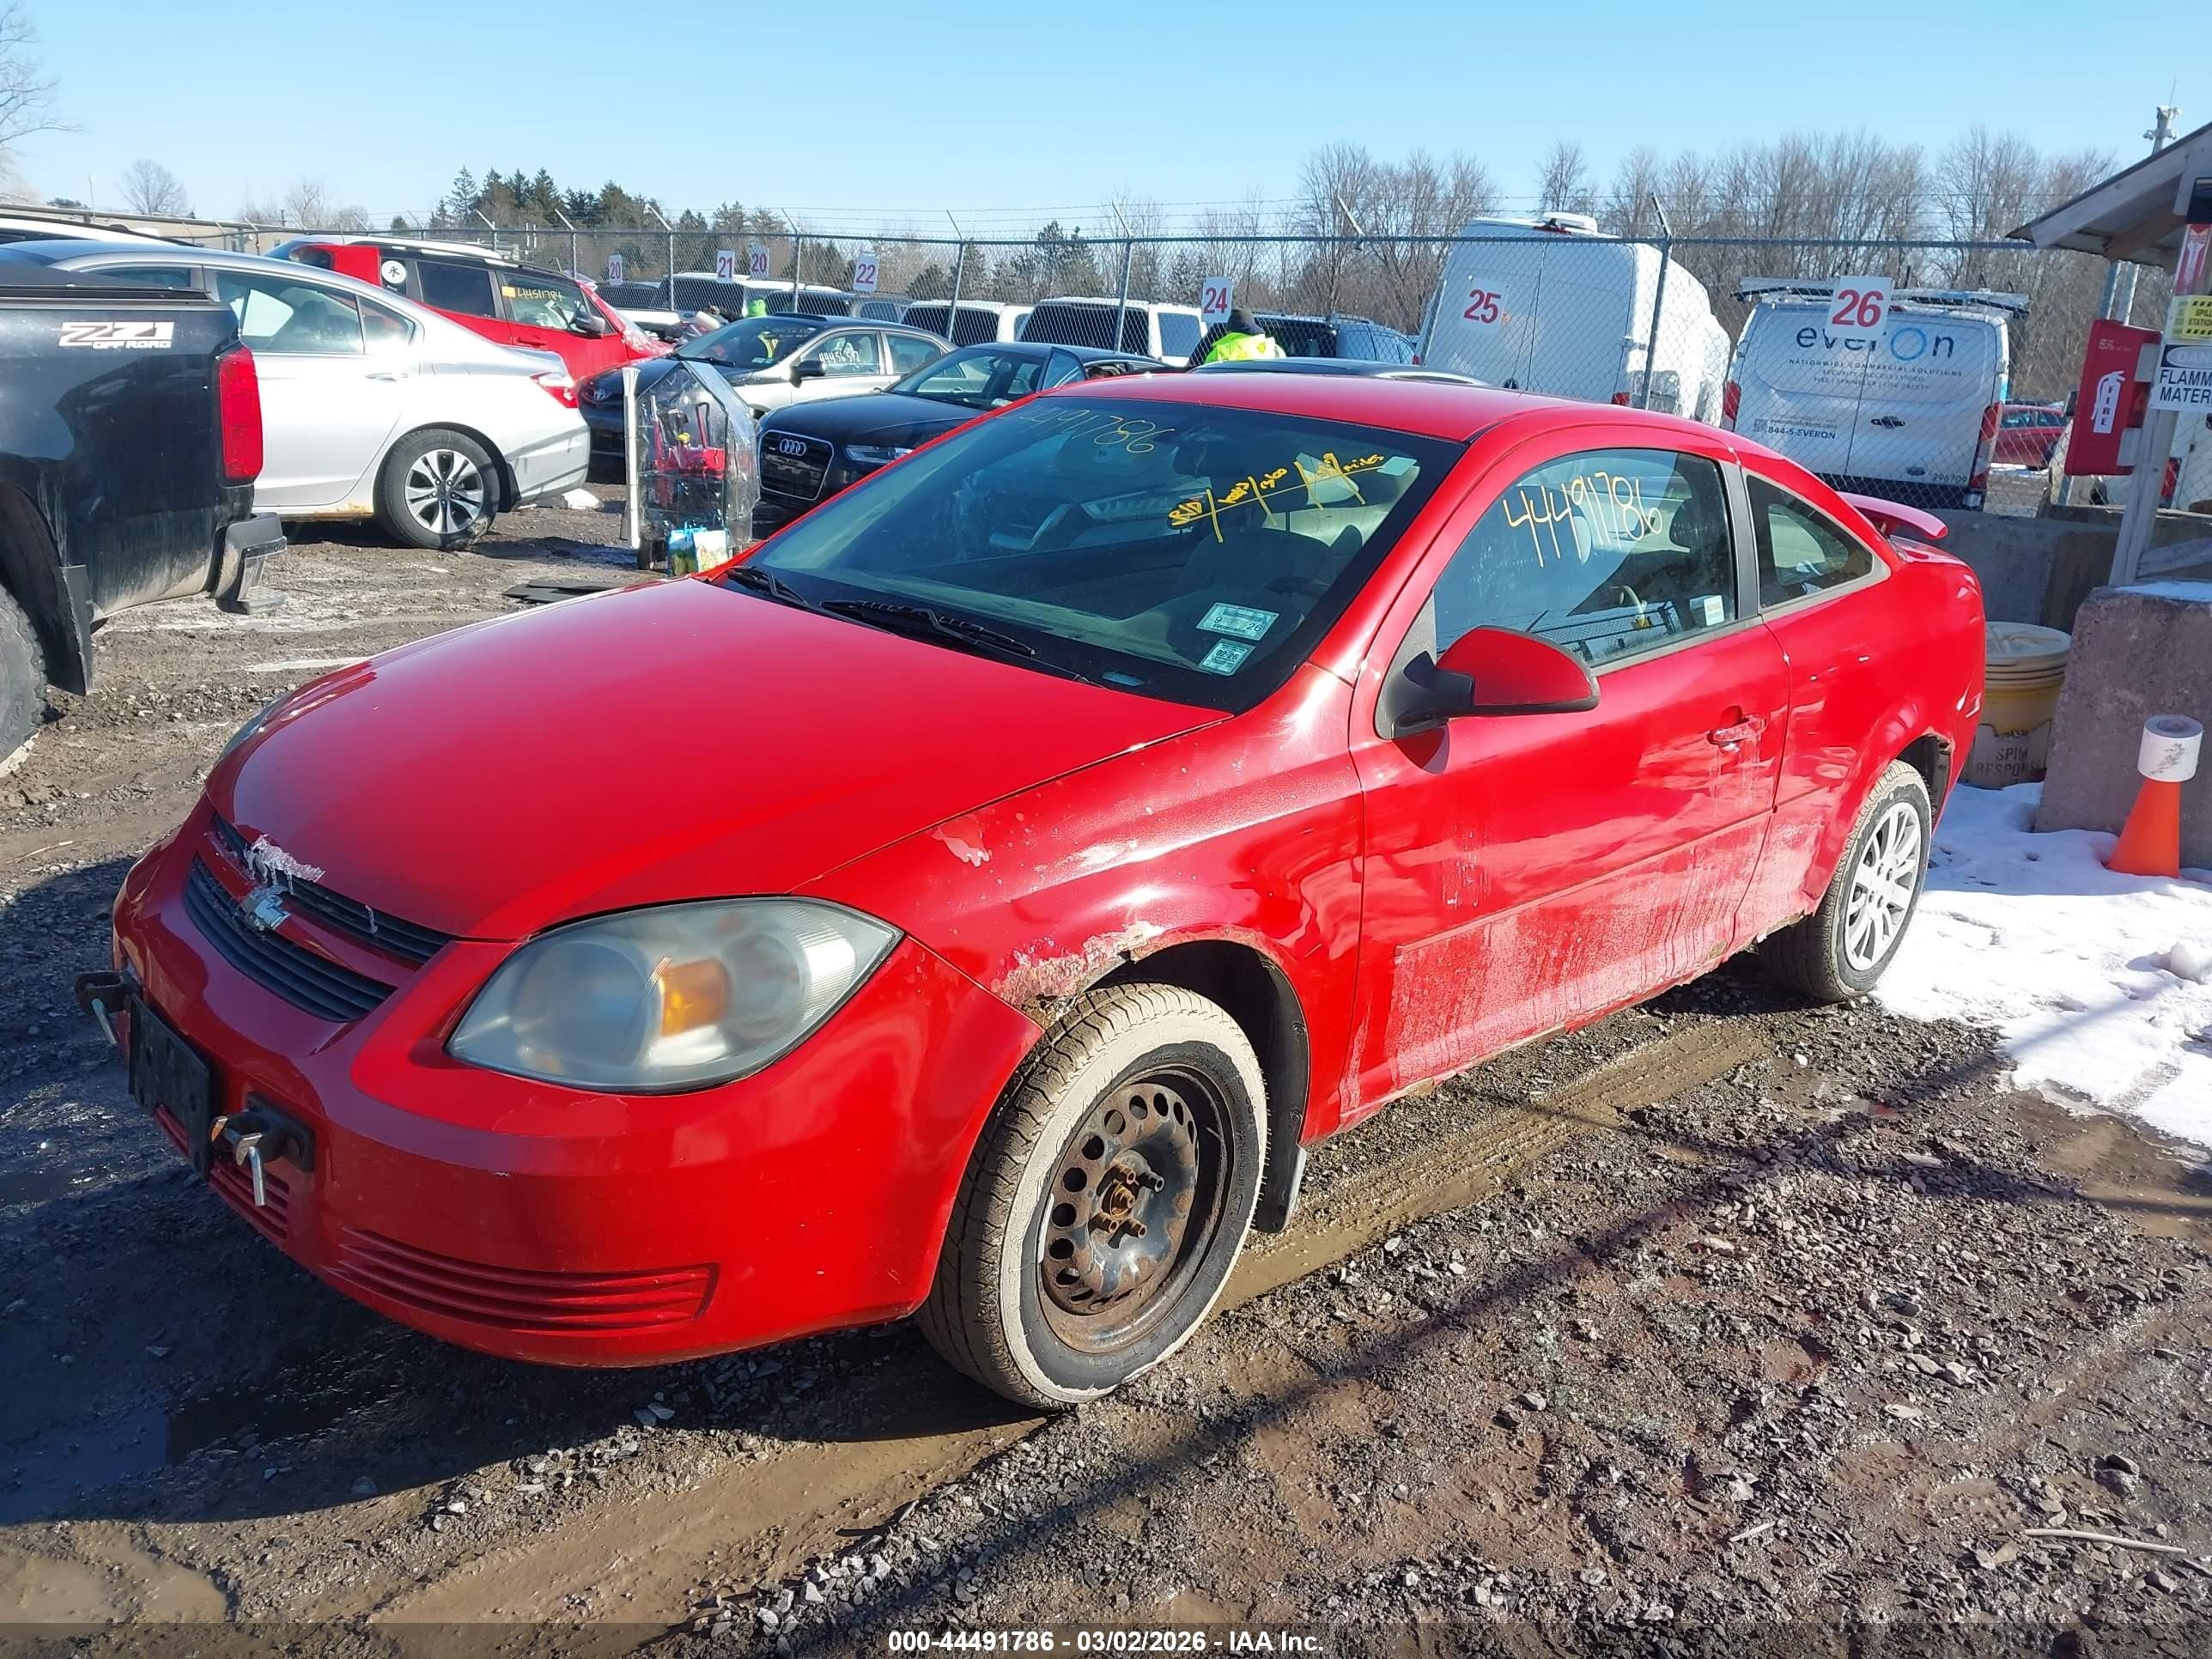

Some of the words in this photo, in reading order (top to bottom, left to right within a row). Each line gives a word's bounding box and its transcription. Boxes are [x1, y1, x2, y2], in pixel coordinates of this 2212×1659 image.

[610, 261, 621, 279] 20
[717, 257, 732, 278] 21
[855, 263, 876, 284] 22
[1203, 287, 1228, 314] 24
[1463, 289, 1502, 324] 25
[1832, 289, 1884, 328] 26
[58, 321, 175, 347] Z71
[2188, 318, 2212, 327] STATIO
[2159, 386, 2212, 405] MATER
[1503, 471, 1663, 568] 44491786
